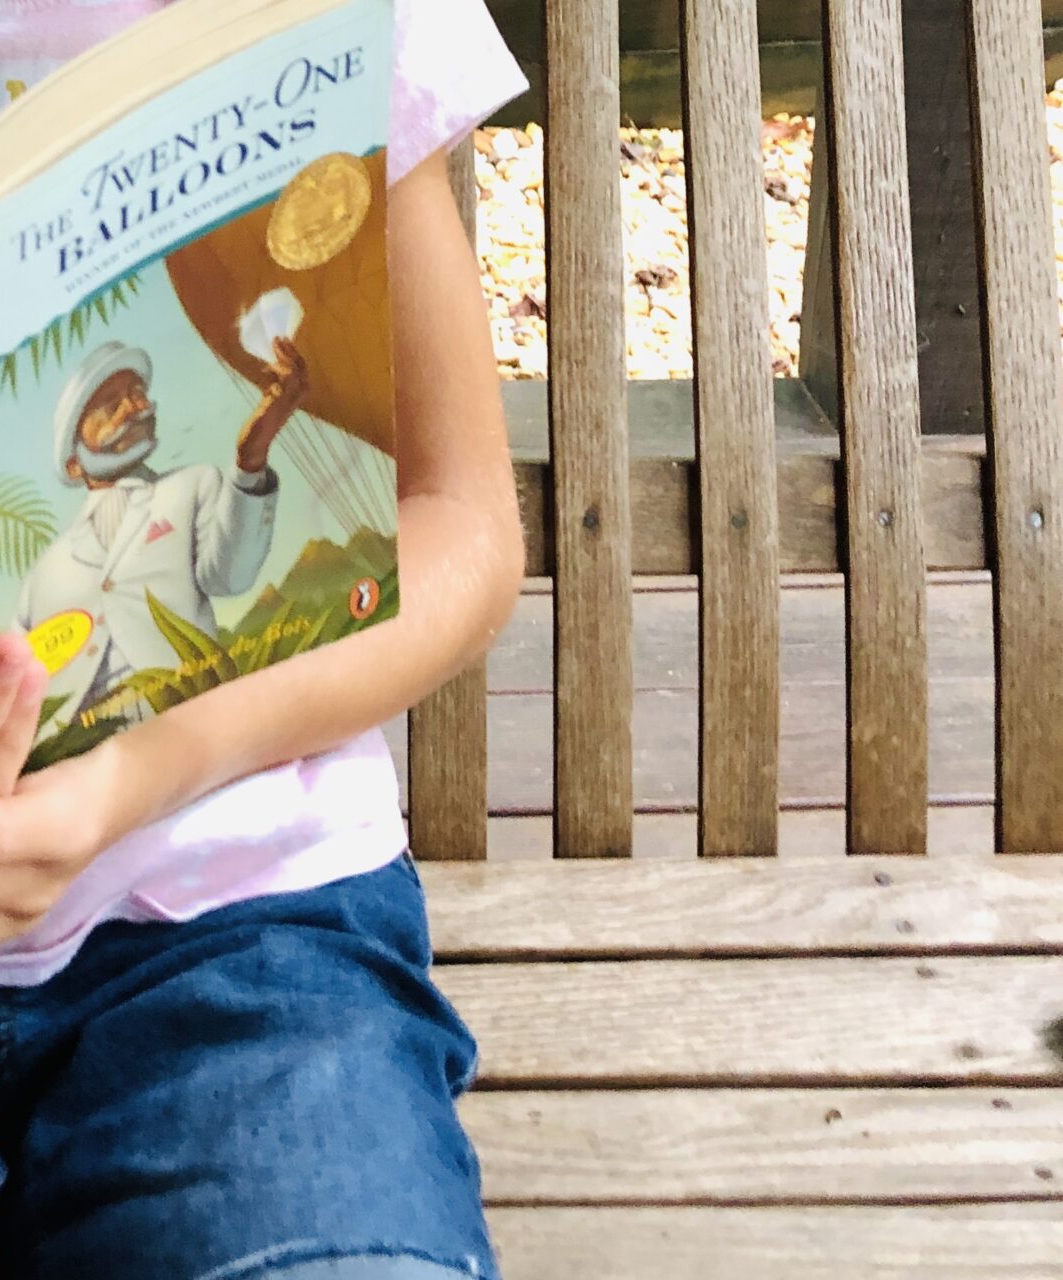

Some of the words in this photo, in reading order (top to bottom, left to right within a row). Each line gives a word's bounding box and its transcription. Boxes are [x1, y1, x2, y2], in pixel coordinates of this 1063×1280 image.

[10, 209, 74, 262] THE
[81, 46, 365, 214] TWENTY-ONE
[57, 108, 317, 276] BALLOONS
[148, 220, 177, 240] THE
